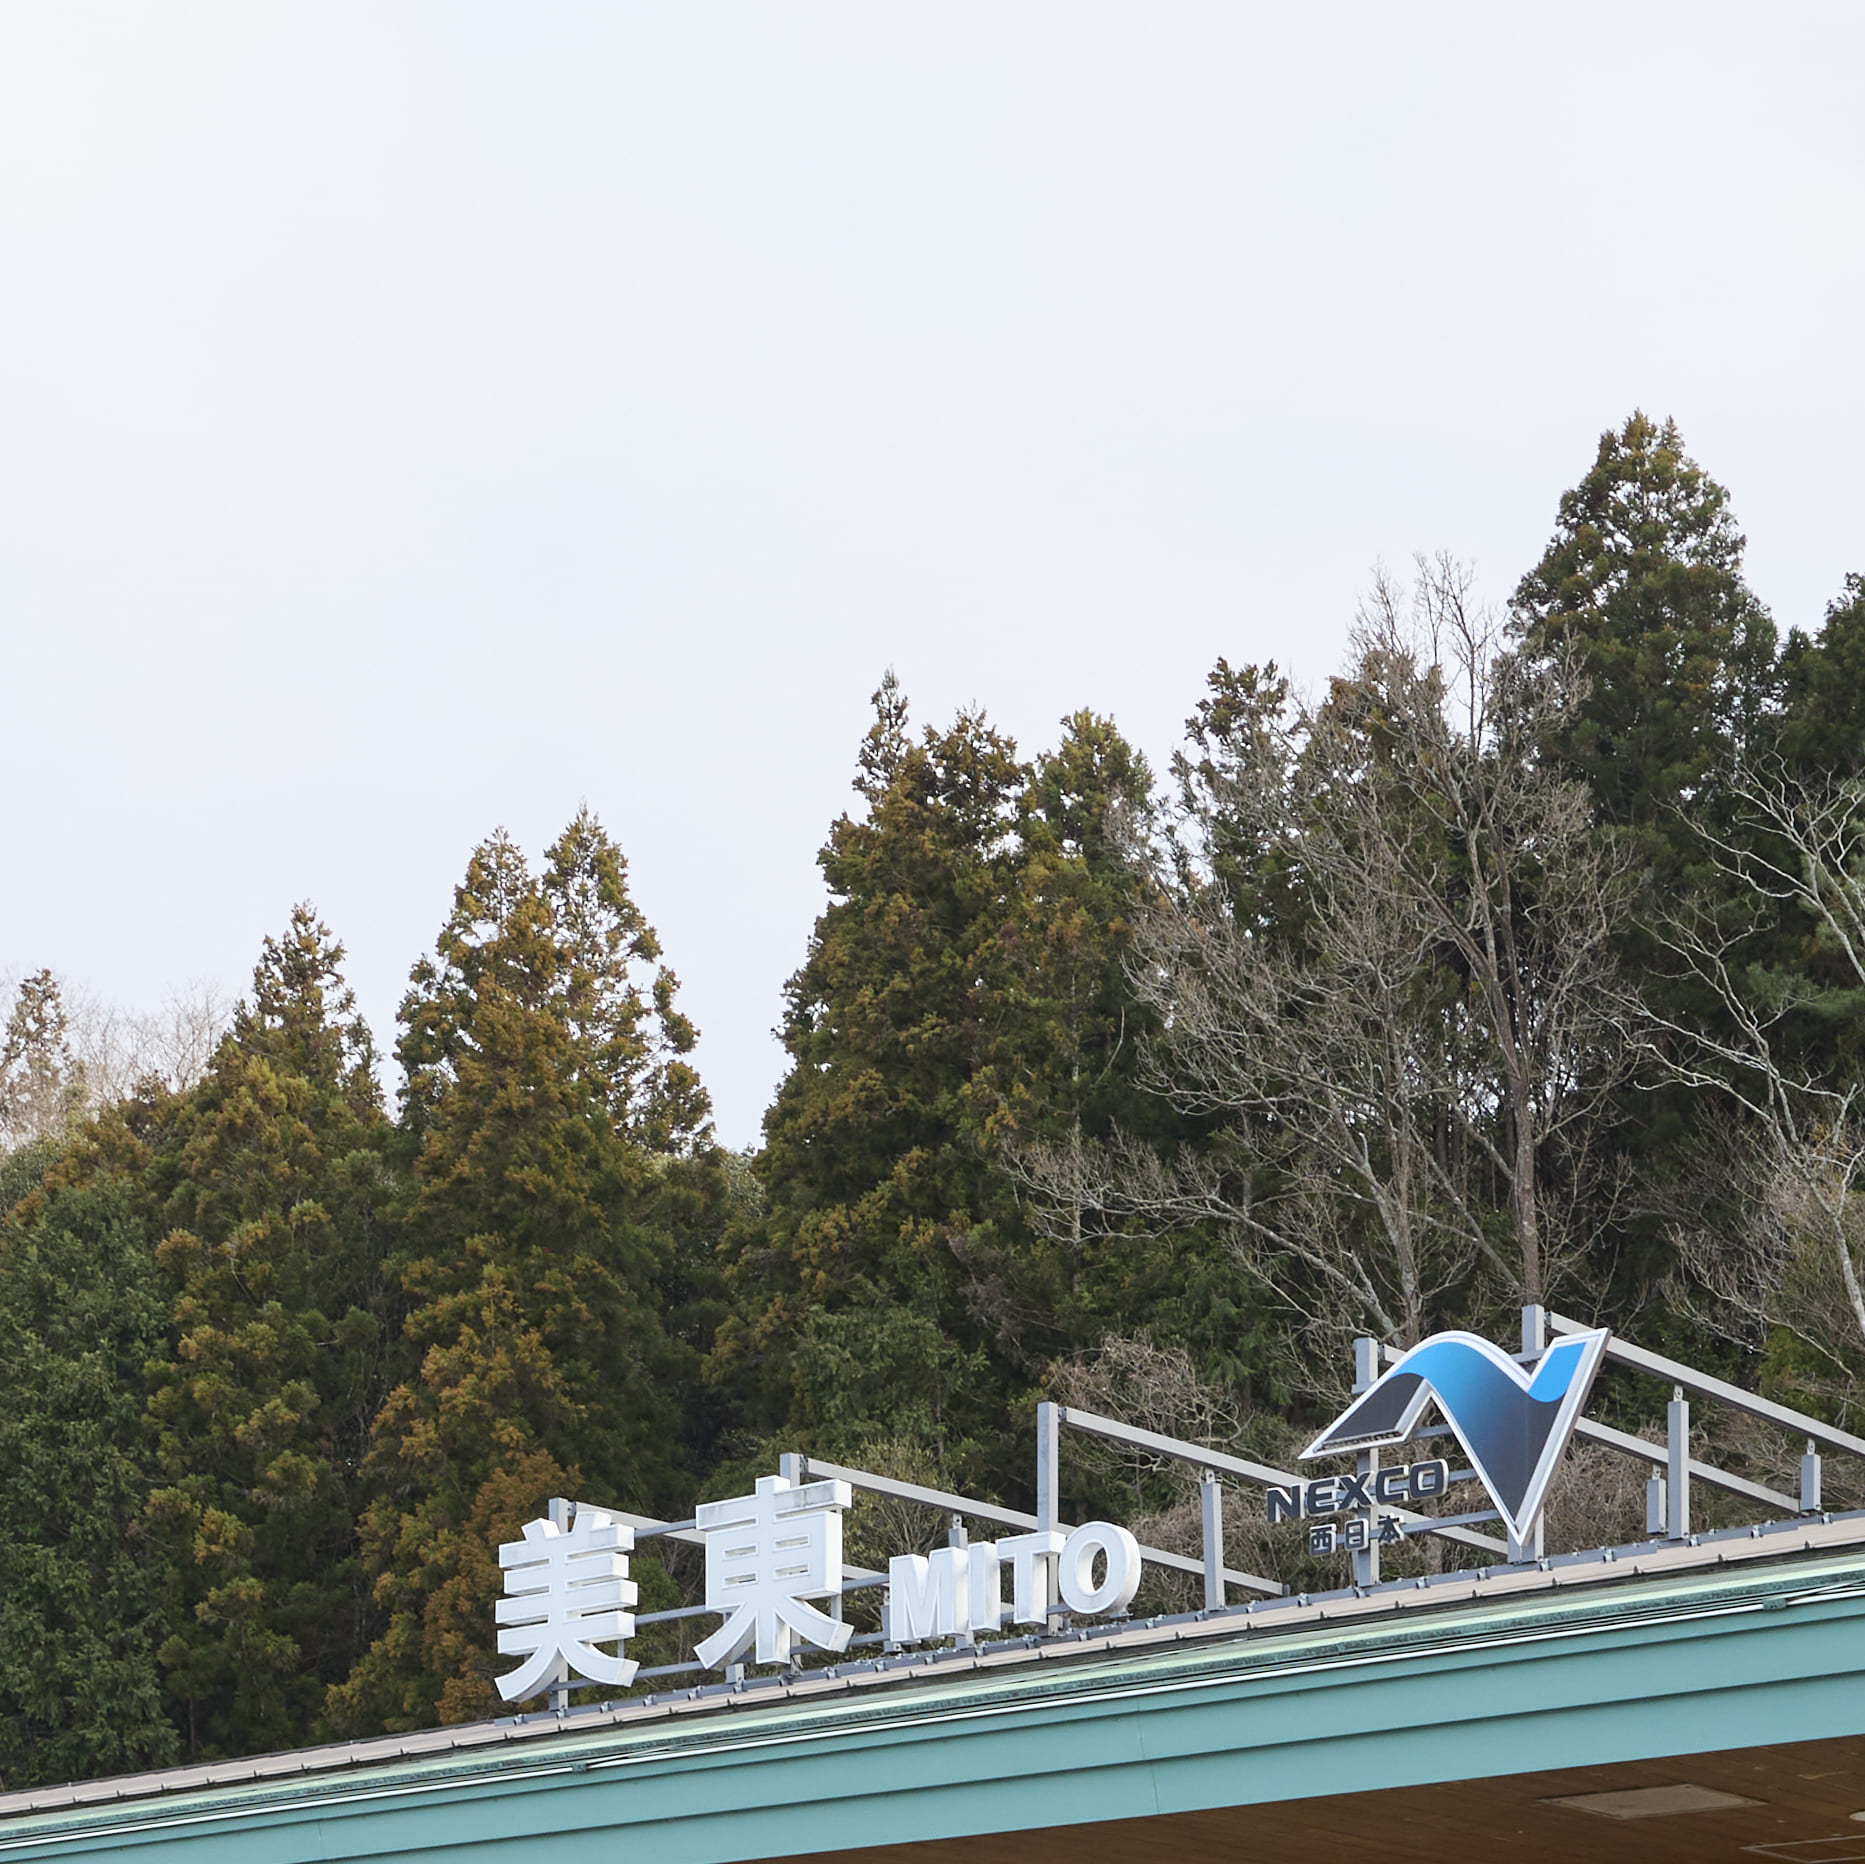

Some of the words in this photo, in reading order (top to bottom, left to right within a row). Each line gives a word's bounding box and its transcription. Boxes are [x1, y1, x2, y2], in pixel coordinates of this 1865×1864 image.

[1267, 1459, 1449, 1523] NEXCO
[1309, 1512, 1405, 1556] 西日本
[495, 1475, 855, 1701] 美東
[889, 1520, 1143, 1644] MITO
